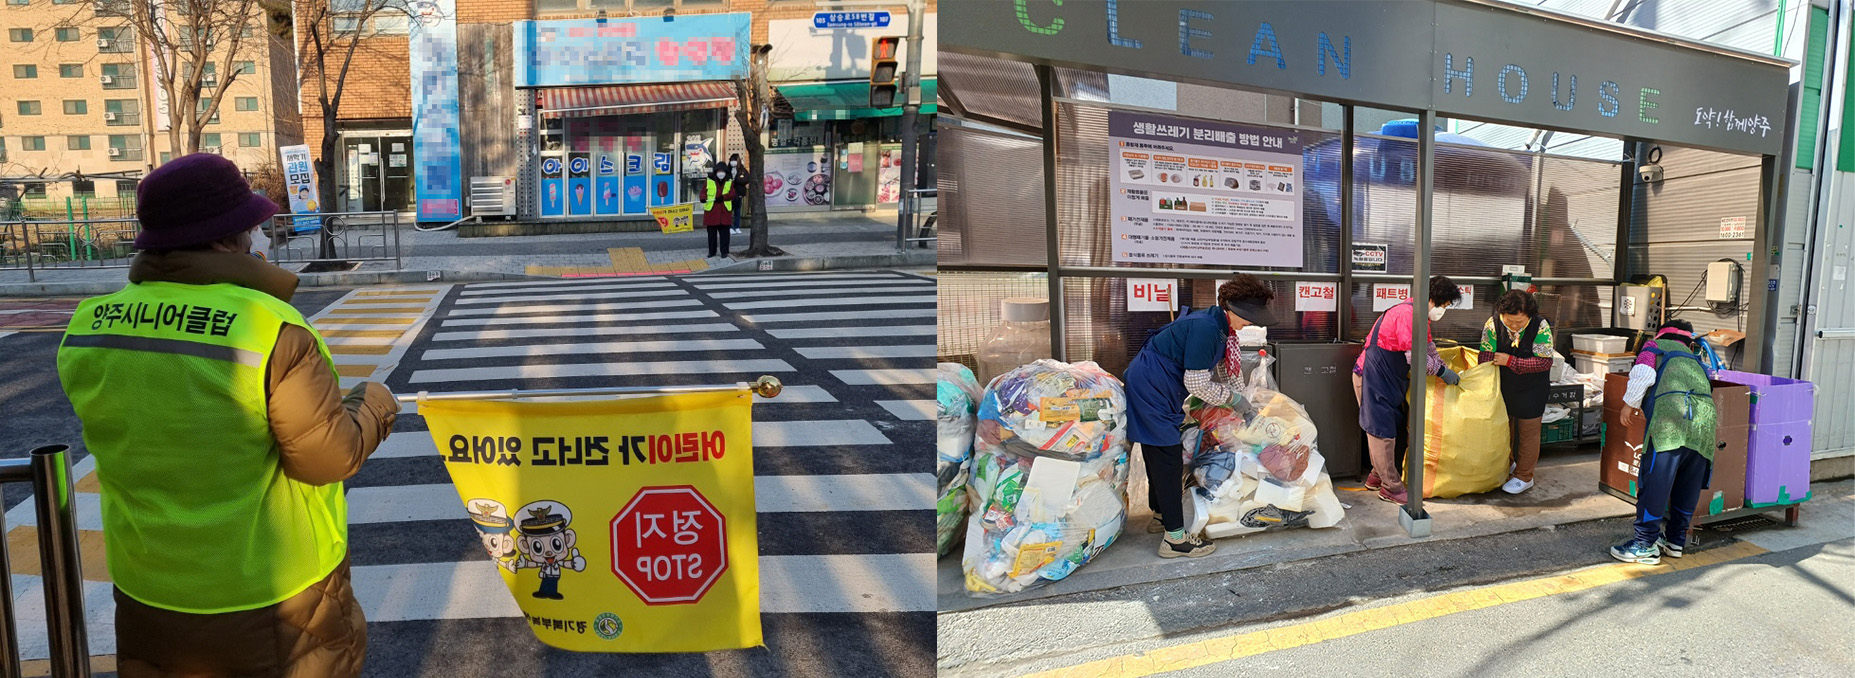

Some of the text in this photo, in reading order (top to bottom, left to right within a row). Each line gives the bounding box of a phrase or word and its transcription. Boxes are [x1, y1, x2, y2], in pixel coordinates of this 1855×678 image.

[829, 12, 875, 22] 삼숭로58번길
[1013, 0, 1351, 79] CLEAN
[1443, 53, 1661, 125] HOUSE
[1694, 107, 1722, 129] 도약!
[1132, 121, 1190, 139] 생활쓰레기
[1193, 127, 1237, 144] 분리배출
[1239, 132, 1260, 146] 방법
[1262, 136, 1283, 149] 안내
[287, 161, 309, 174] 관원
[542, 152, 672, 174] 아이스크림
[289, 172, 311, 185] 모집
[1133, 283, 1172, 302] 비닐
[1298, 286, 1334, 299] 캔고철
[1376, 287, 1408, 301] 패트병
[91, 302, 238, 337] 양주시니어클럽
